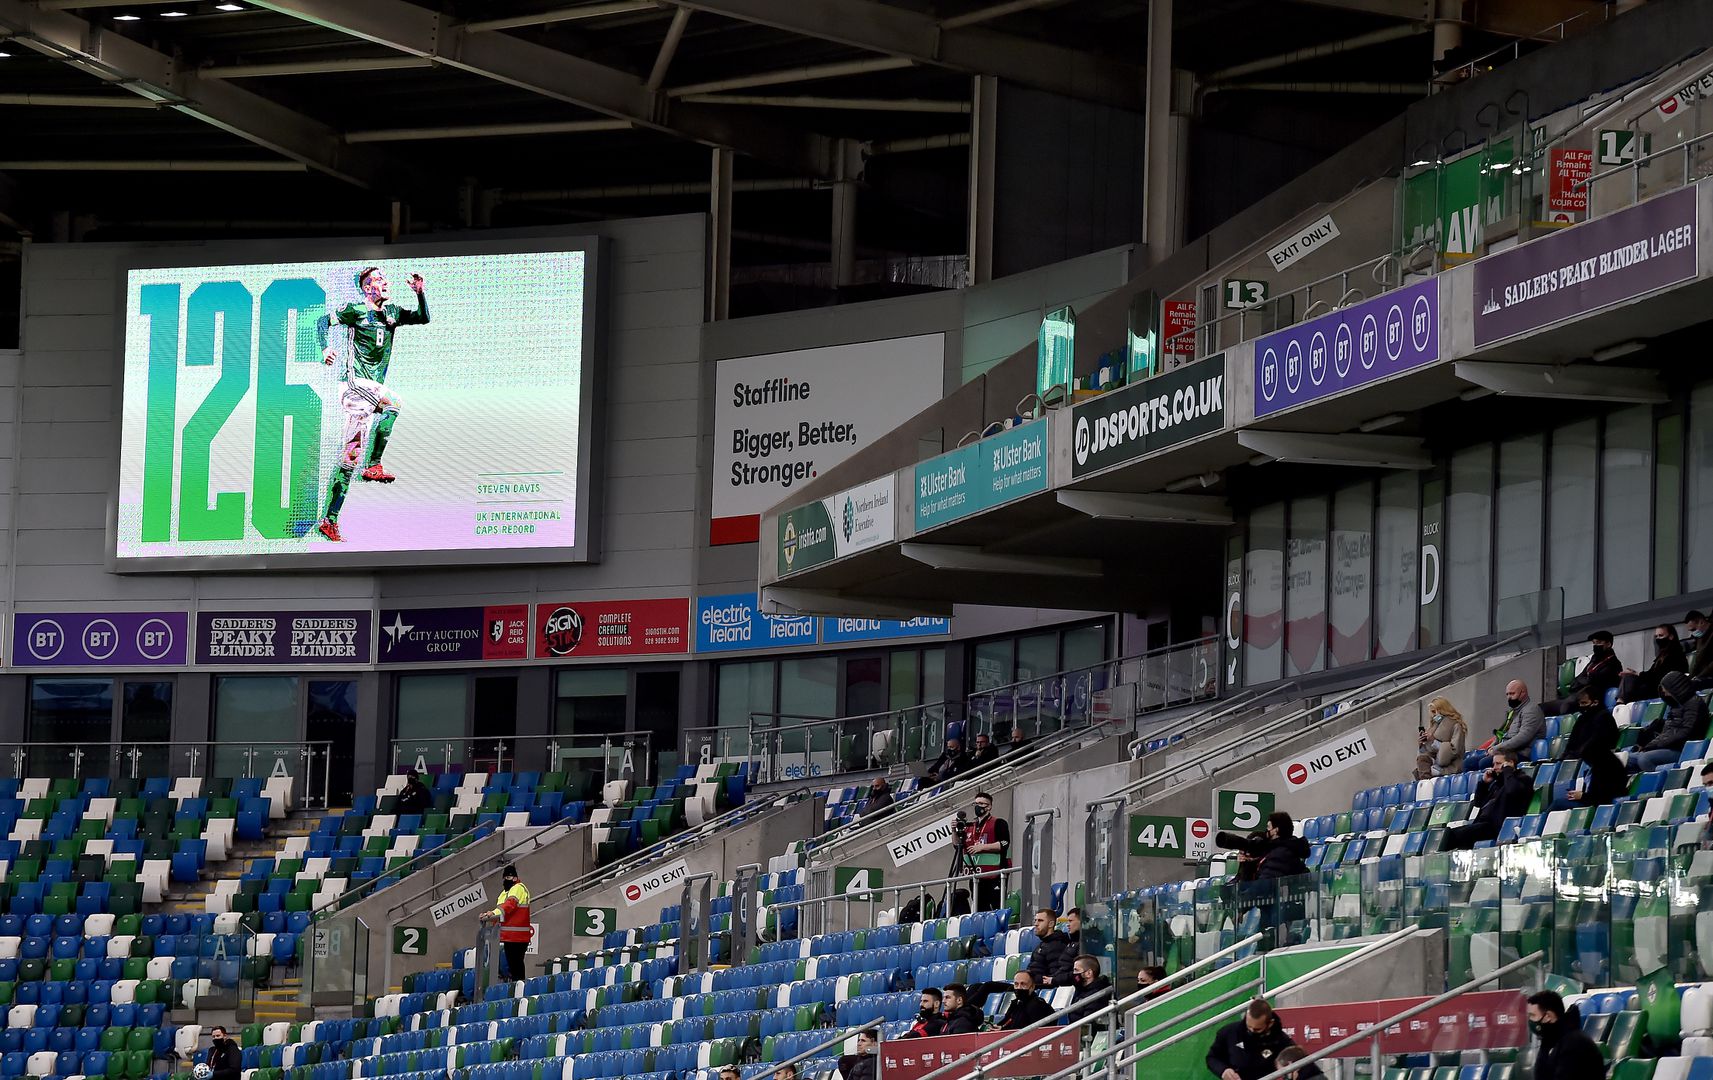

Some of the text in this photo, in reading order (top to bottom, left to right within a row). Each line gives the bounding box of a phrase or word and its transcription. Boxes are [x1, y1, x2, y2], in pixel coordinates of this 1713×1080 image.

[1564, 152, 1576, 160] All
[1601, 132, 1648, 164] 14
[1556, 160, 1587, 169] Remain
[1558, 169, 1569, 177] All
[1273, 222, 1332, 265] EXIT ONLY
[1504, 224, 1692, 308] SADLER'S PEAKY BLINDER LAGER
[1227, 280, 1265, 310] 13
[1389, 322, 1400, 344] BT
[1415, 313, 1427, 335] BT
[1338, 339, 1349, 361] BT
[1363, 331, 1374, 352] BT
[1289, 356, 1299, 377] BT
[1313, 347, 1323, 369] BT
[1265, 364, 1275, 385] BT
[733, 377, 810, 407] Staffline
[141, 277, 326, 542] 126
[1091, 375, 1223, 454] JDSPORTS.CO.UK
[732, 421, 857, 458] Bigger, Better,
[1000, 435, 1041, 470] Ulster Bank
[731, 460, 817, 487] Stronger.
[927, 462, 966, 496] Ulster Bank
[992, 475, 1003, 493] Help
[1011, 469, 1022, 485] what
[1022, 466, 1042, 482] matters
[477, 483, 540, 494] STEVEN DAVIS
[476, 511, 561, 521] UK INTERNATIONAL
[920, 502, 930, 519] Help
[937, 497, 948, 511] what
[948, 492, 966, 508] matters
[476, 525, 536, 534] CAPS RECORD
[1423, 522, 1439, 536] BLOCK
[1421, 544, 1440, 606] D
[213, 619, 275, 630] SADLER'S
[294, 619, 356, 630] SADLER'S
[508, 620, 525, 628] JACK
[598, 612, 632, 624] COMPLETE
[702, 603, 751, 625] electric
[1227, 591, 1240, 650] C
[90, 631, 111, 647] BT
[144, 631, 165, 647] BT
[209, 630, 276, 645] PEAKY
[291, 630, 357, 645] PEAKY
[409, 629, 479, 641] CITY AUCTION
[509, 628, 523, 636] REID
[598, 624, 627, 635] CREATIVE
[709, 620, 751, 643] Ireland
[769, 617, 812, 639] Ireland
[36, 631, 57, 648] BT
[426, 642, 461, 653] GROUP
[507, 636, 525, 644] CARS
[597, 636, 632, 646] SOLUTIONS
[209, 645, 275, 657] BLINDER
[291, 645, 357, 657] BLINDER
[1309, 738, 1368, 774] NO EXIT
[1232, 792, 1261, 829] 5
[892, 824, 953, 859] EXIT ONL
[1136, 823, 1179, 850] 4A
[642, 865, 686, 892] NO EXIT
[845, 869, 873, 900] 4
[433, 888, 482, 920] EXIT ONLY
[585, 908, 605, 936] 3
[401, 927, 420, 954] 2
